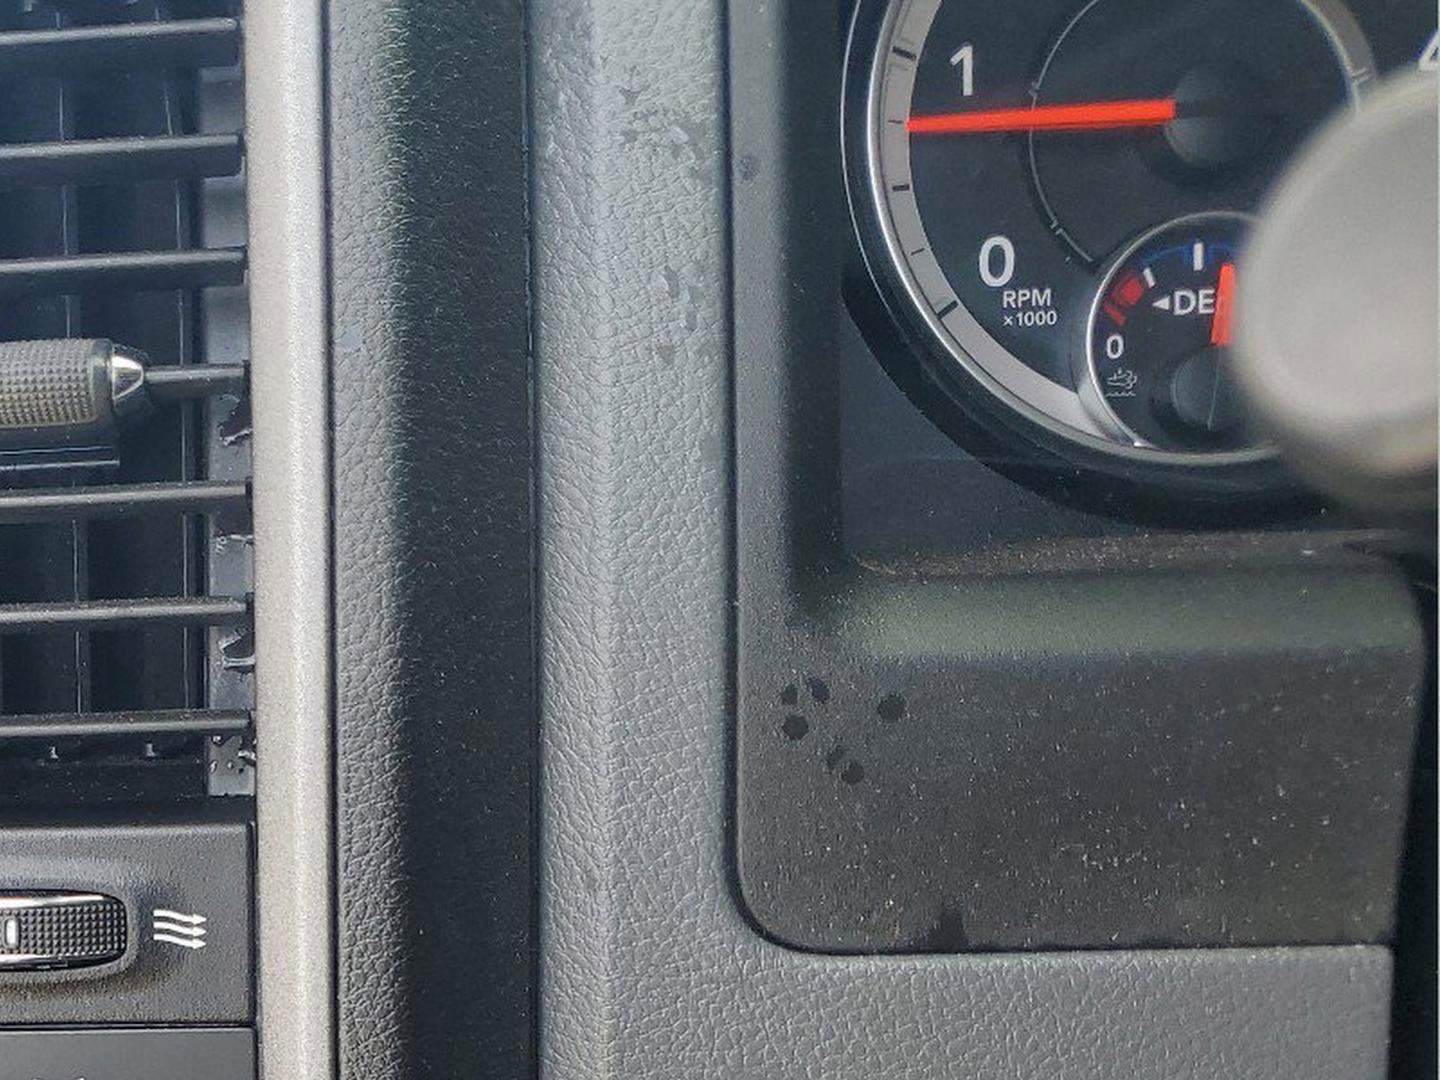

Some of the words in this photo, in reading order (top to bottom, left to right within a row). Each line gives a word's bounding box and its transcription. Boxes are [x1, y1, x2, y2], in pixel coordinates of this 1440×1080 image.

[950, 45, 973, 96] 1
[979, 236, 1014, 287] 0
[1003, 288, 1052, 308] RPM
[1173, 288, 1216, 316] DE
[1106, 334, 1124, 359] 0
